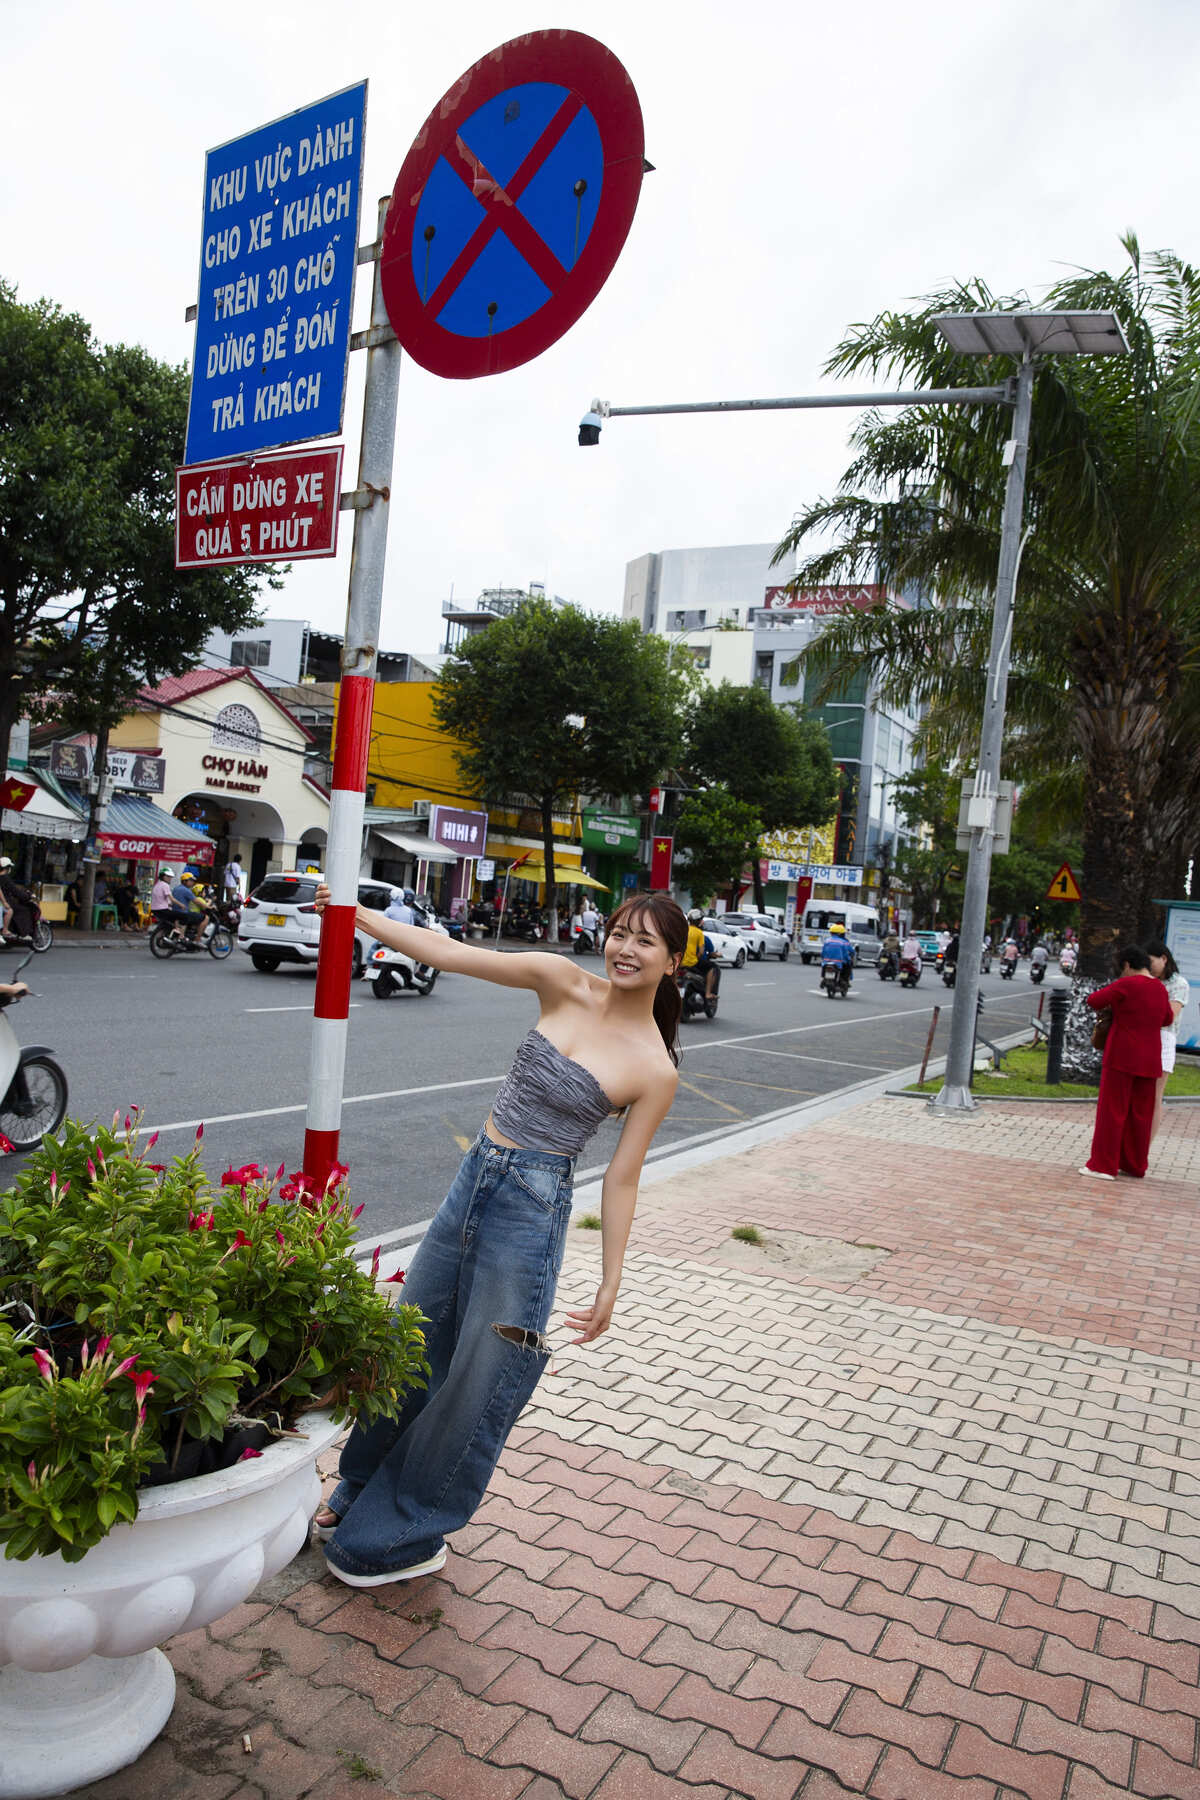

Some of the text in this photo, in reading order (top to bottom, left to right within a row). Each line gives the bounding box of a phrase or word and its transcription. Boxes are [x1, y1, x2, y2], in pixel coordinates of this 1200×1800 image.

[210, 117, 354, 213] KHU VỰC DÀNH
[205, 180, 351, 269] CHO XE KHÁCH
[213, 234, 340, 321] TRÊN 30 CHỖ
[206, 300, 339, 380] DỪNG ĐỂ ĐÓN
[211, 371, 322, 433] TRẢ KHÁCH
[186, 472, 324, 517] CẤM DỪNG XE
[195, 512, 313, 557] QUÁ 5 PHÚT
[797, 588, 873, 602] DRAGON
[104, 766, 127, 777] OBY
[202, 755, 268, 779] CHỢ HÀN
[227, 781, 261, 793] MARKET
[119, 839, 154, 854] GOBY
[442, 821, 470, 842] HIHI
[756, 829, 828, 847] RAGON
